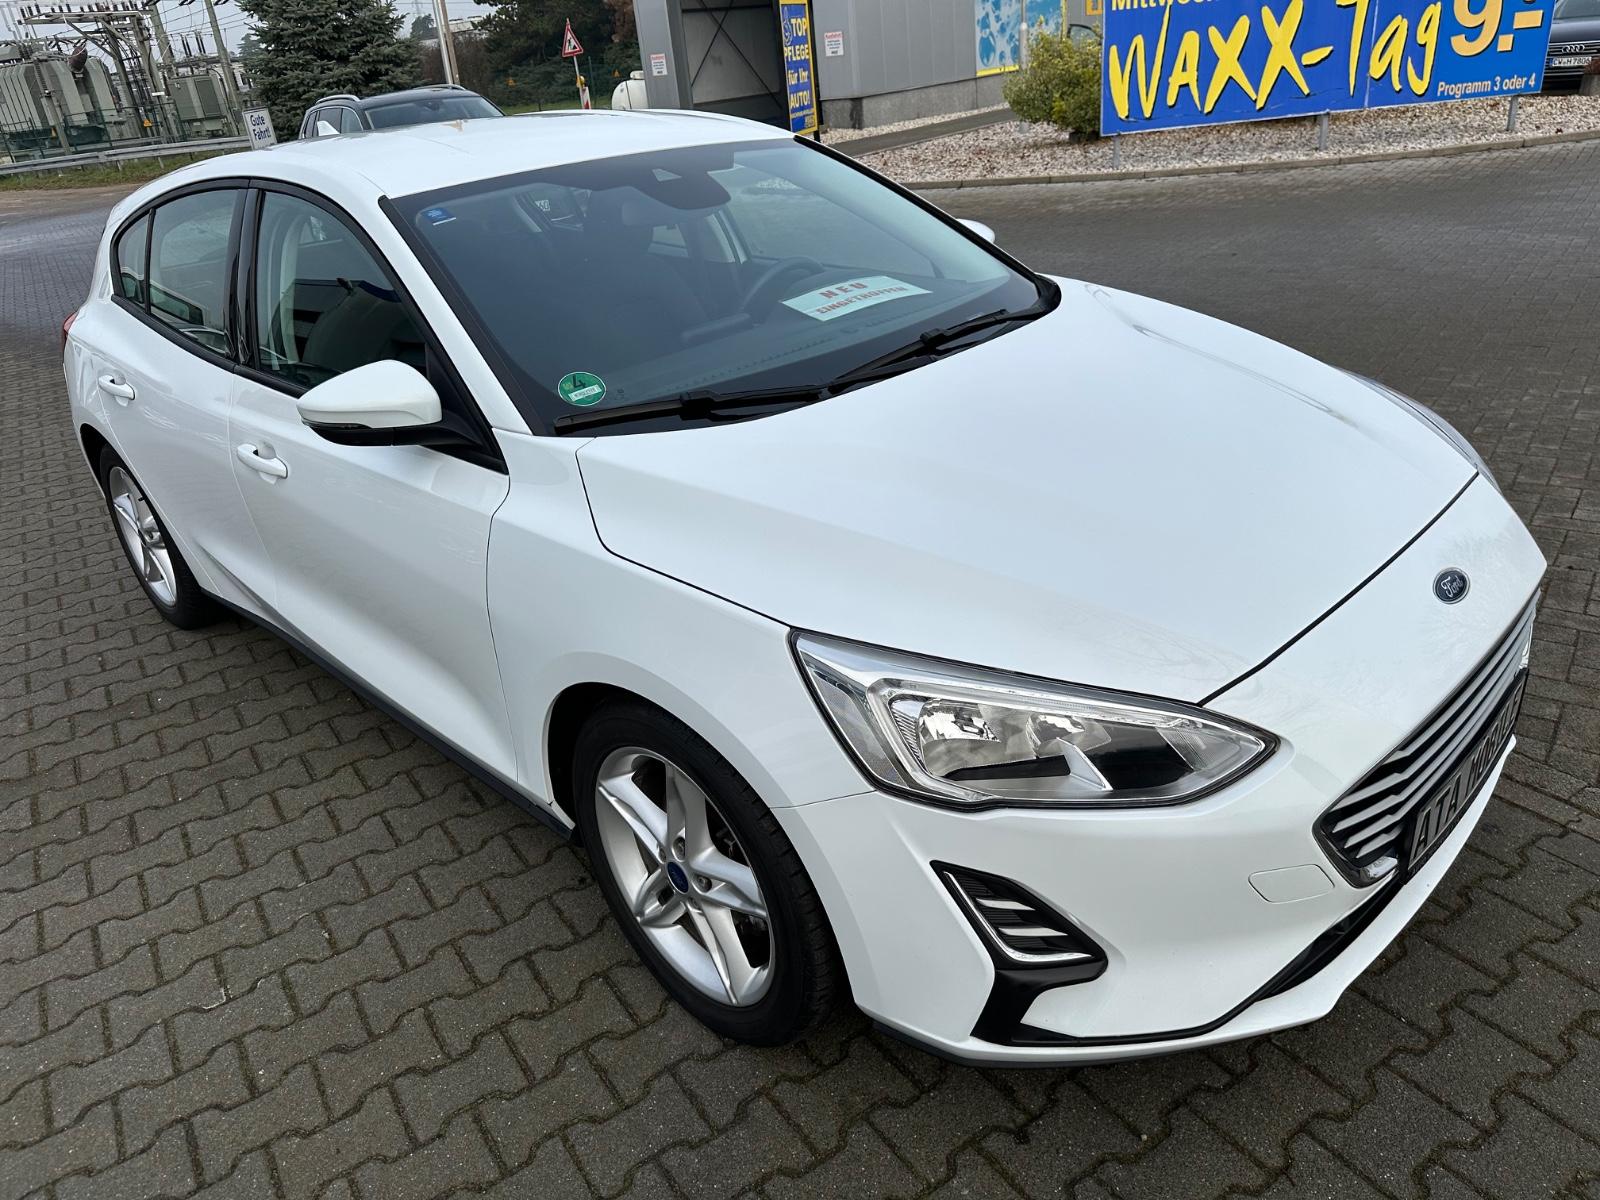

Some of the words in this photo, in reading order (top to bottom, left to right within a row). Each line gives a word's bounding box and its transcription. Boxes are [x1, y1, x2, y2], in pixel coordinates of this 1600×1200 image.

[791, 17, 807, 37] TOP
[783, 44, 809, 61] PFLEGE
[788, 69, 798, 85] für
[799, 68, 808, 83] Ihr
[1437, 81, 1491, 98] Programm
[1493, 76, 1501, 91] 3
[1502, 74, 1527, 90] oder
[1528, 73, 1536, 88] 4
[790, 91, 810, 108] AUTO!
[250, 114, 265, 126] Gute
[253, 127, 271, 140] Fahrt!
[819, 282, 868, 299] NEU
[572, 373, 586, 388] 4
[1441, 575, 1463, 597] Ford
[1413, 773, 1462, 860] ATA
